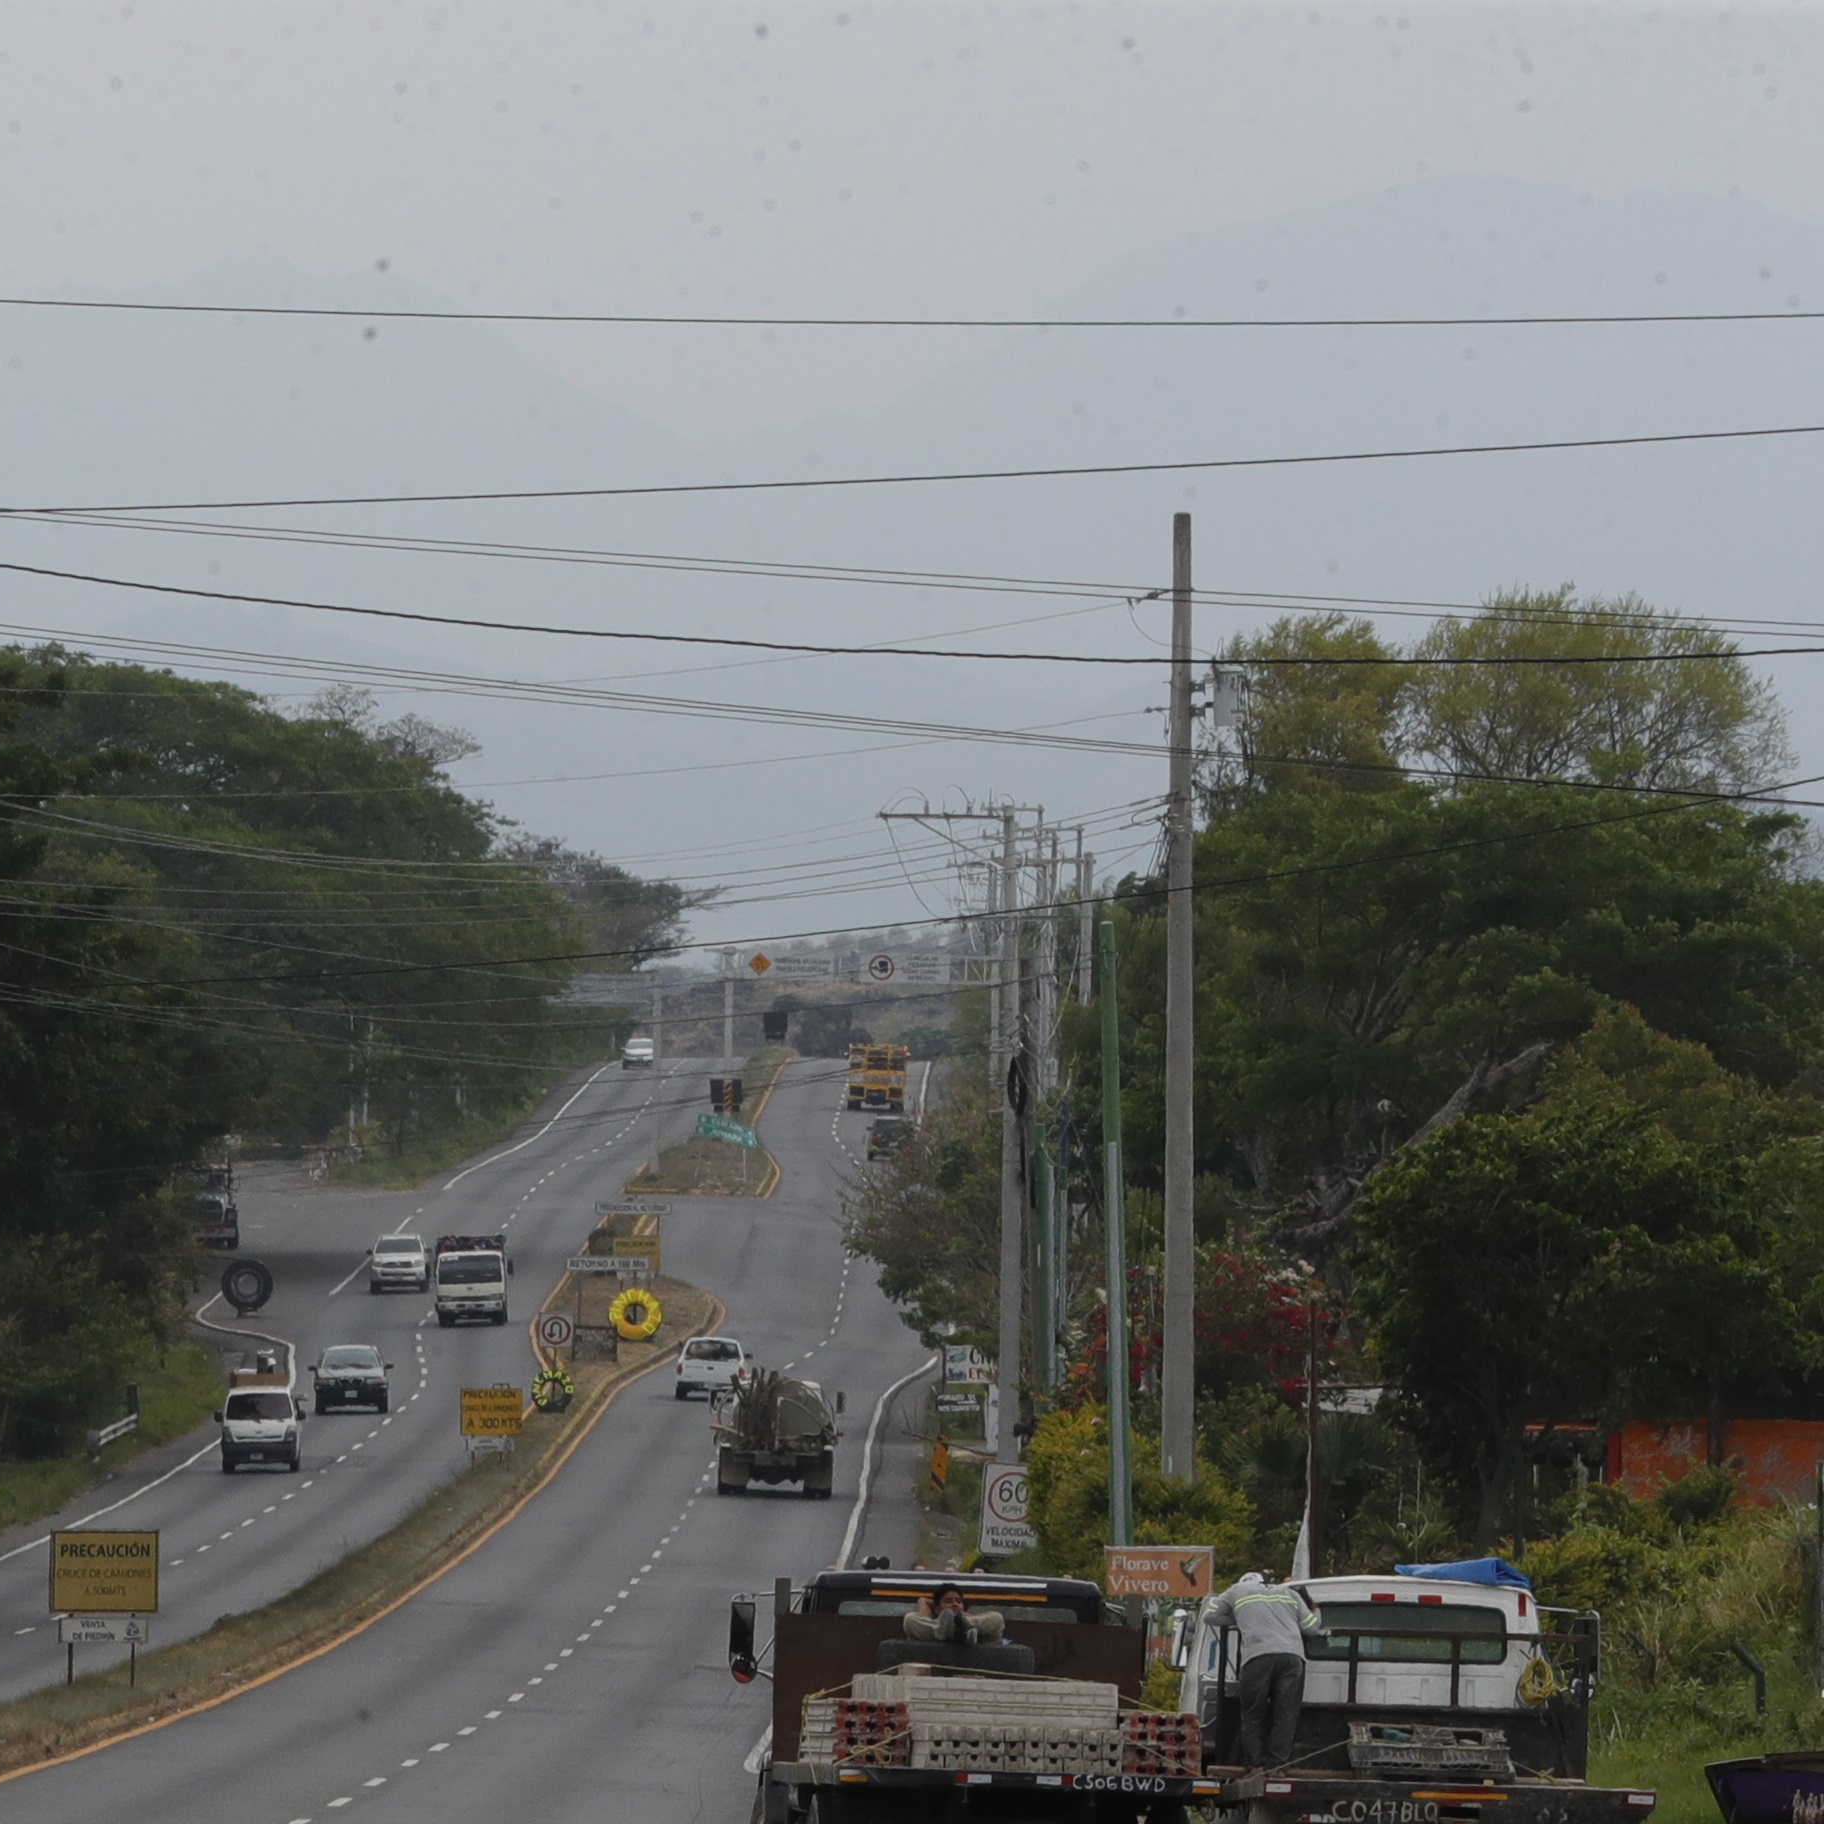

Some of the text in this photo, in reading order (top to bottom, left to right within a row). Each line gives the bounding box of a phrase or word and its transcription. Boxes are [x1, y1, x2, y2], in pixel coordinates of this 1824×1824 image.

[569, 1259, 608, 1268] RETORNO
[609, 1259, 616, 1268] A
[998, 1480, 1029, 1504] 60
[60, 1541, 151, 1558] PRECAUCIÓN
[1111, 1555, 1169, 1571] Florave
[89, 1567, 101, 1579] DE
[1108, 1575, 1170, 1593] Vivero
